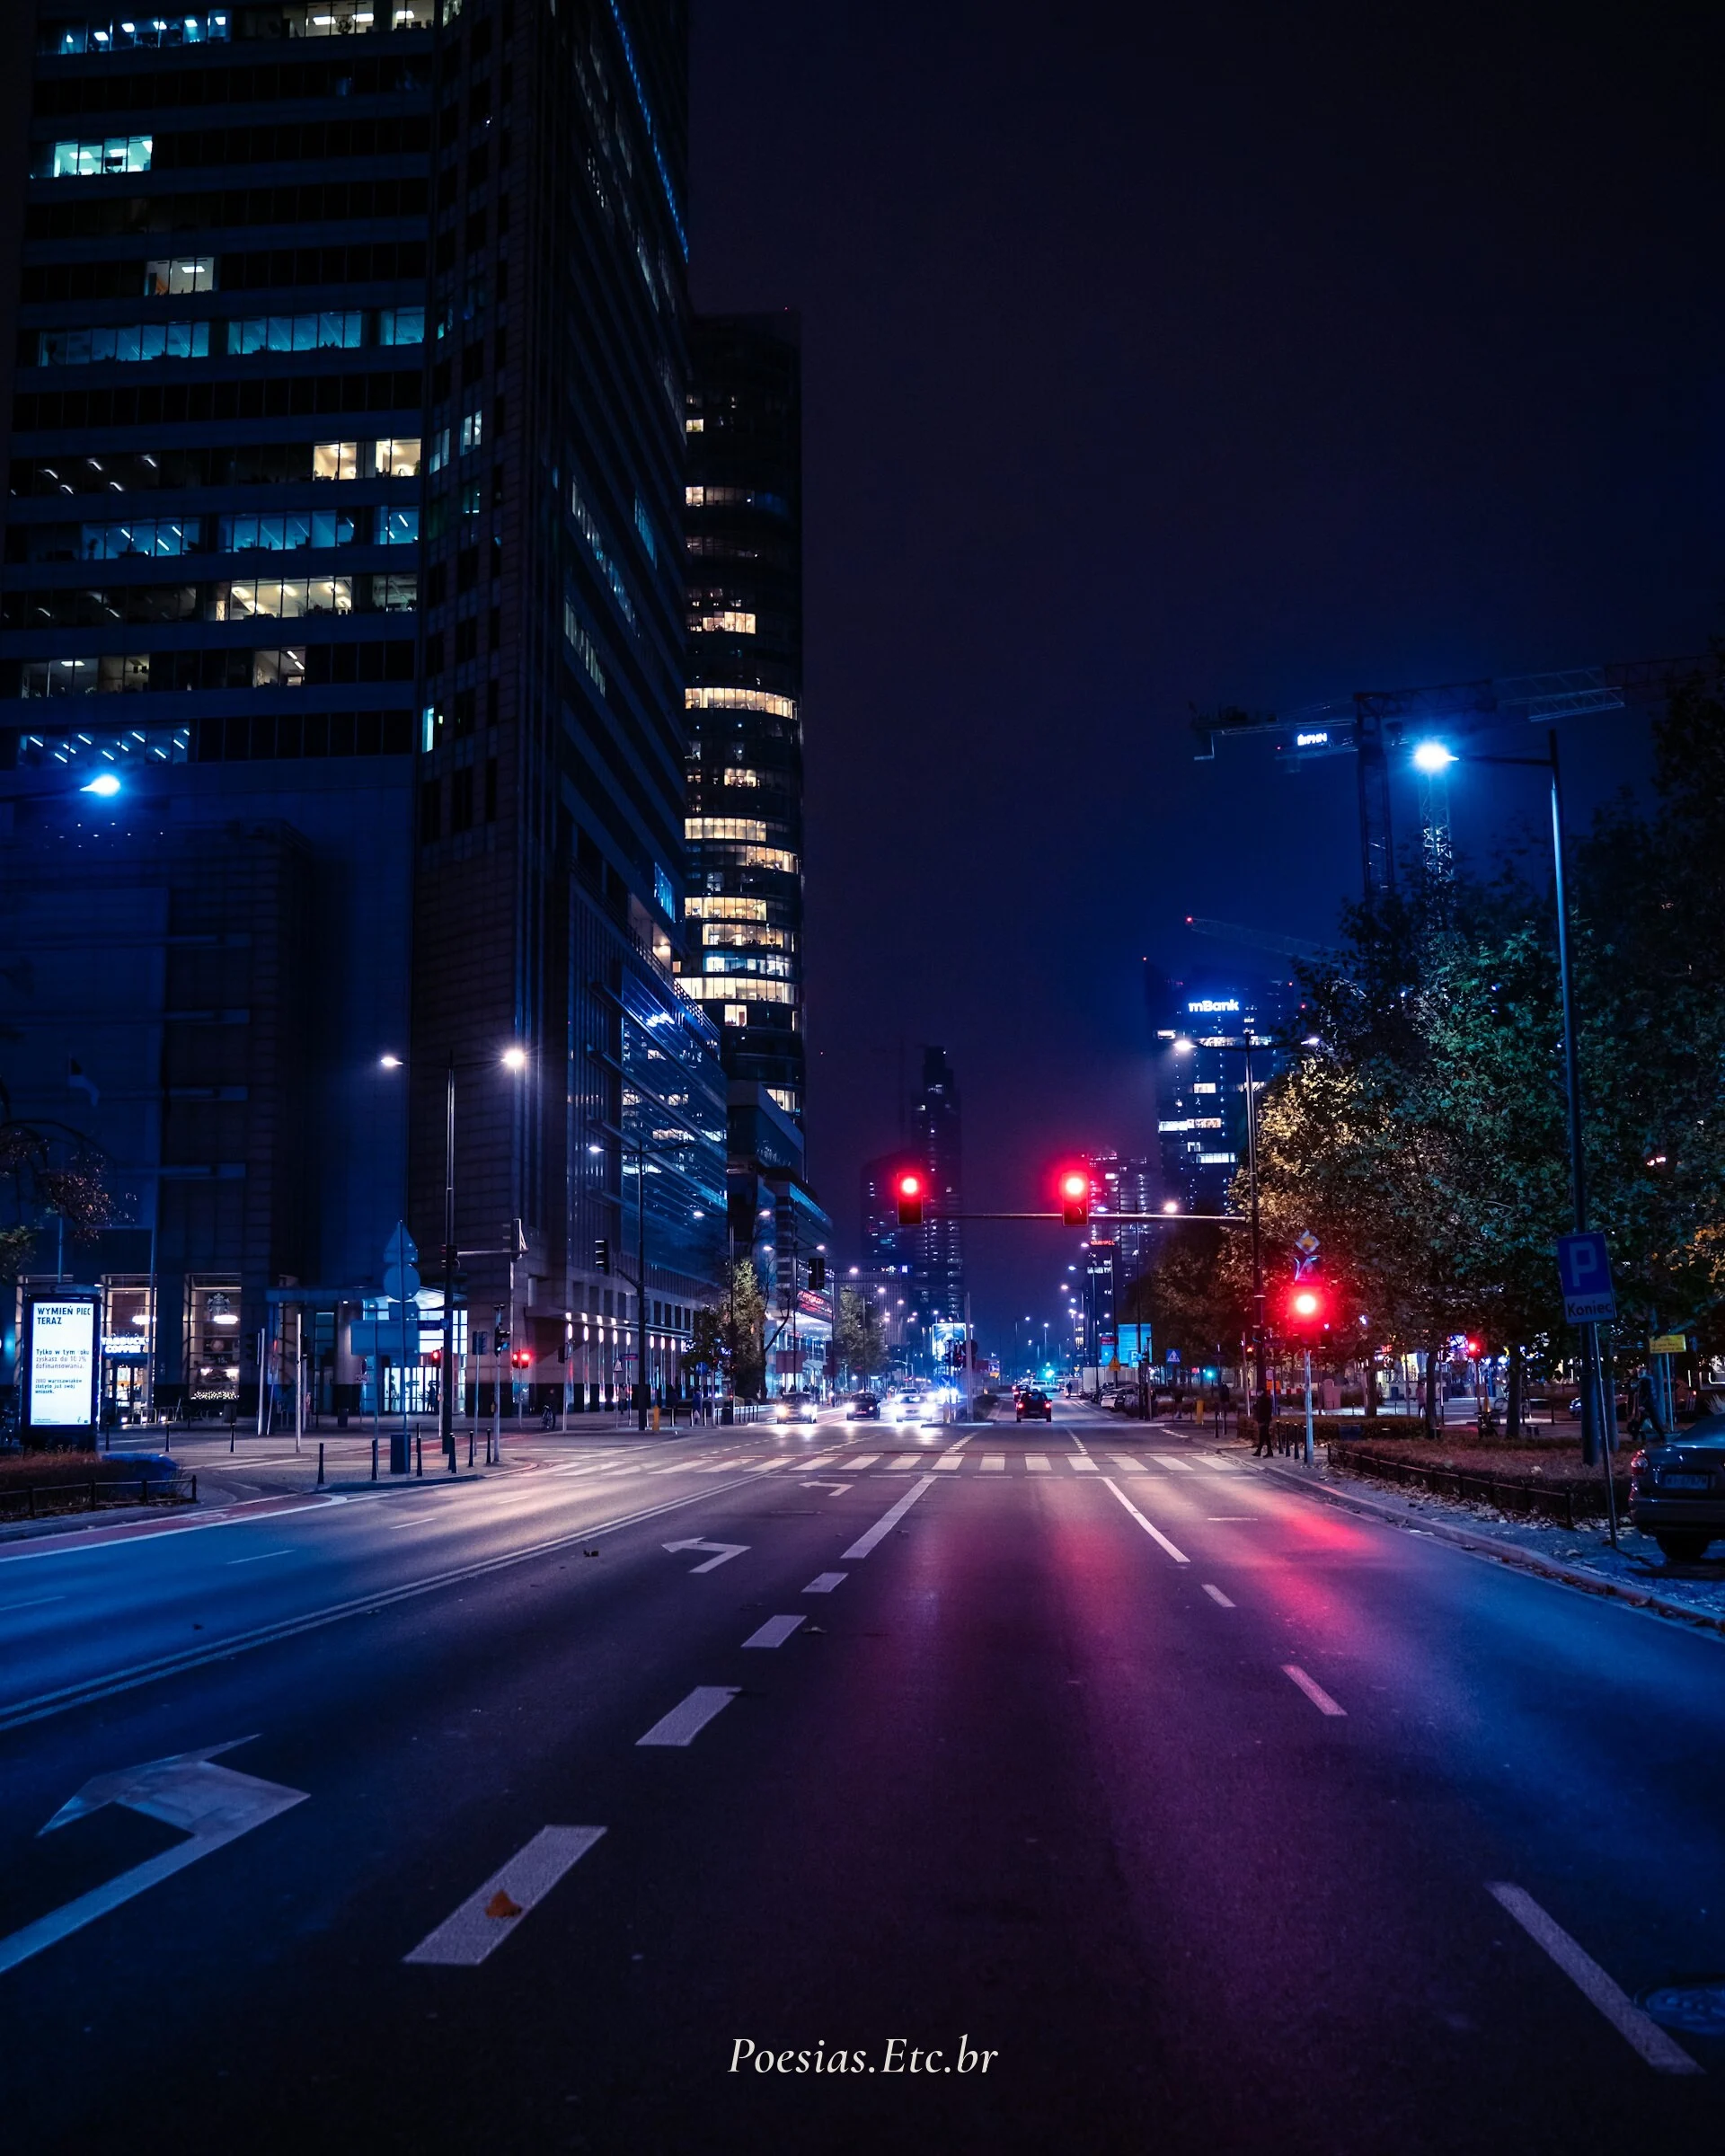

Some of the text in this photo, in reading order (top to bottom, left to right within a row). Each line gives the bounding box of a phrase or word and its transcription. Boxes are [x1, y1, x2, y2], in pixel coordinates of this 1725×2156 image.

[1189, 999, 1239, 1012] mBank
[1569, 1241, 1597, 1286] P
[37, 1305, 74, 1315] WYMIEŃ
[1567, 1300, 1613, 1318] Koniec
[37, 1316, 62, 1325] TERAZ
